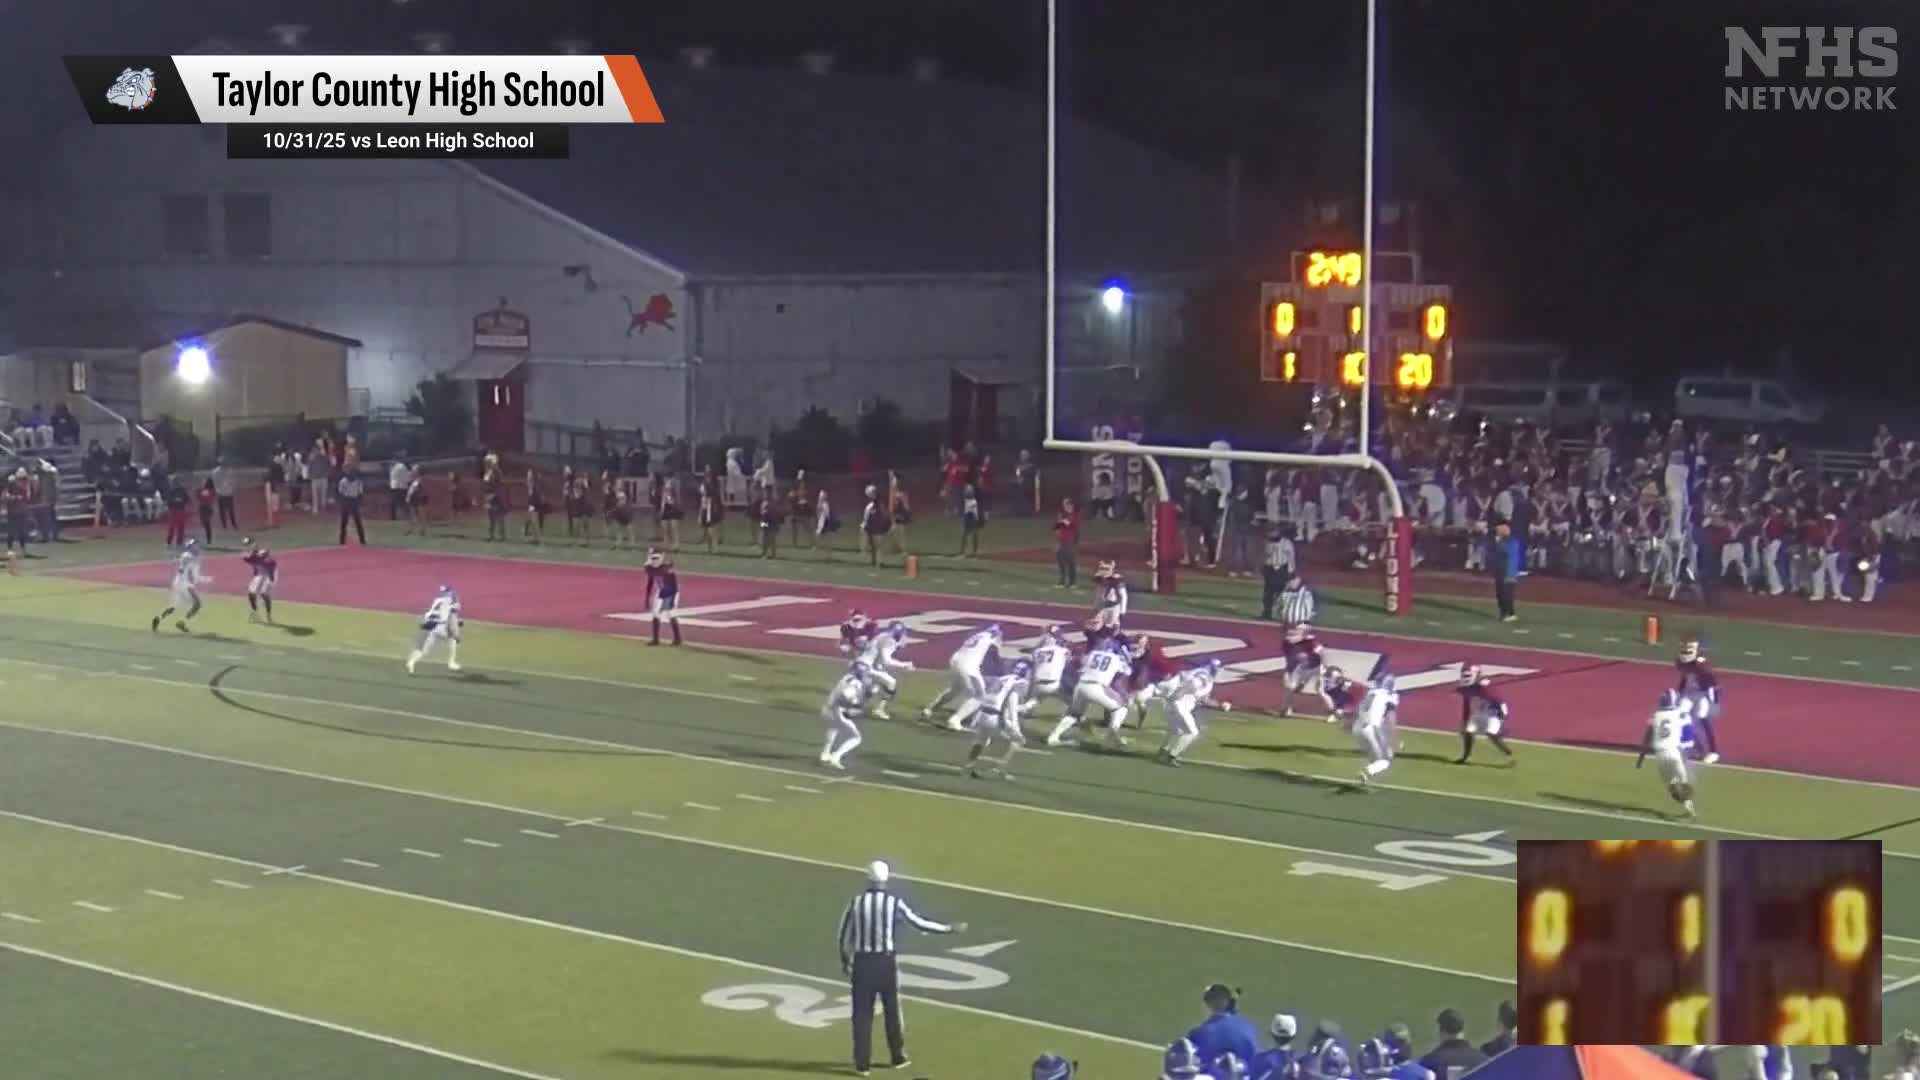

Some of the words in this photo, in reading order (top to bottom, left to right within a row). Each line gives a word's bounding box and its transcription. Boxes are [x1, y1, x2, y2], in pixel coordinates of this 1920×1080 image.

[1275, 302, 1294, 337] 0
[1426, 305, 1445, 340] 0
[1398, 353, 1433, 387] 20
